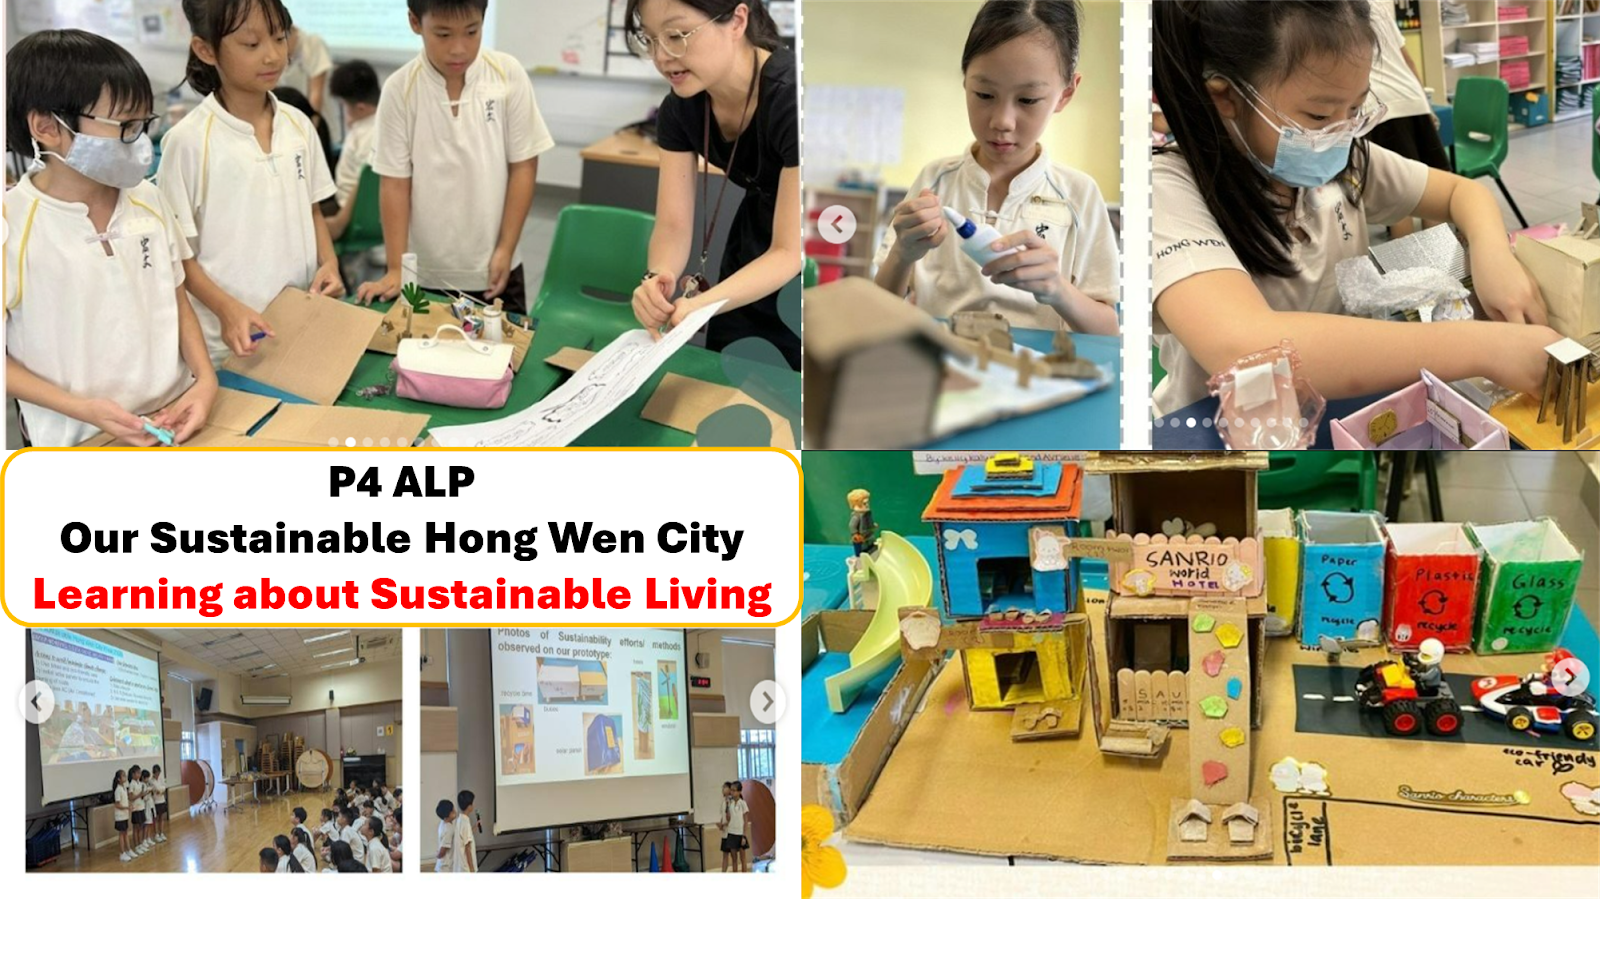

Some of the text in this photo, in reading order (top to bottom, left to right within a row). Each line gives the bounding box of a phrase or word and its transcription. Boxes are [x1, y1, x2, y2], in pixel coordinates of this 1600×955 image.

[1156, 238, 1191, 260] HONG
[1146, 550, 1228, 567] SANRIO
[1321, 554, 1358, 566] Paper
[1169, 568, 1210, 579] world
[1415, 568, 1474, 581] Plastic
[1512, 574, 1565, 589] Glass
[1172, 580, 1219, 589] HOTEL
[1417, 621, 1458, 632] recycle
[1503, 626, 1552, 636] recycle
[497, 628, 531, 638] Photos
[540, 630, 549, 640] of
[558, 631, 612, 648] Sustainability
[652, 640, 681, 651] methods
[498, 642, 613, 660] observed on our prototype:
[1503, 747, 1596, 768] eco-friendly
[1515, 759, 1545, 767] car
[1399, 786, 1518, 803] Sanrio characters
[1288, 802, 1310, 853] bicycle
[1307, 816, 1326, 847] lane
